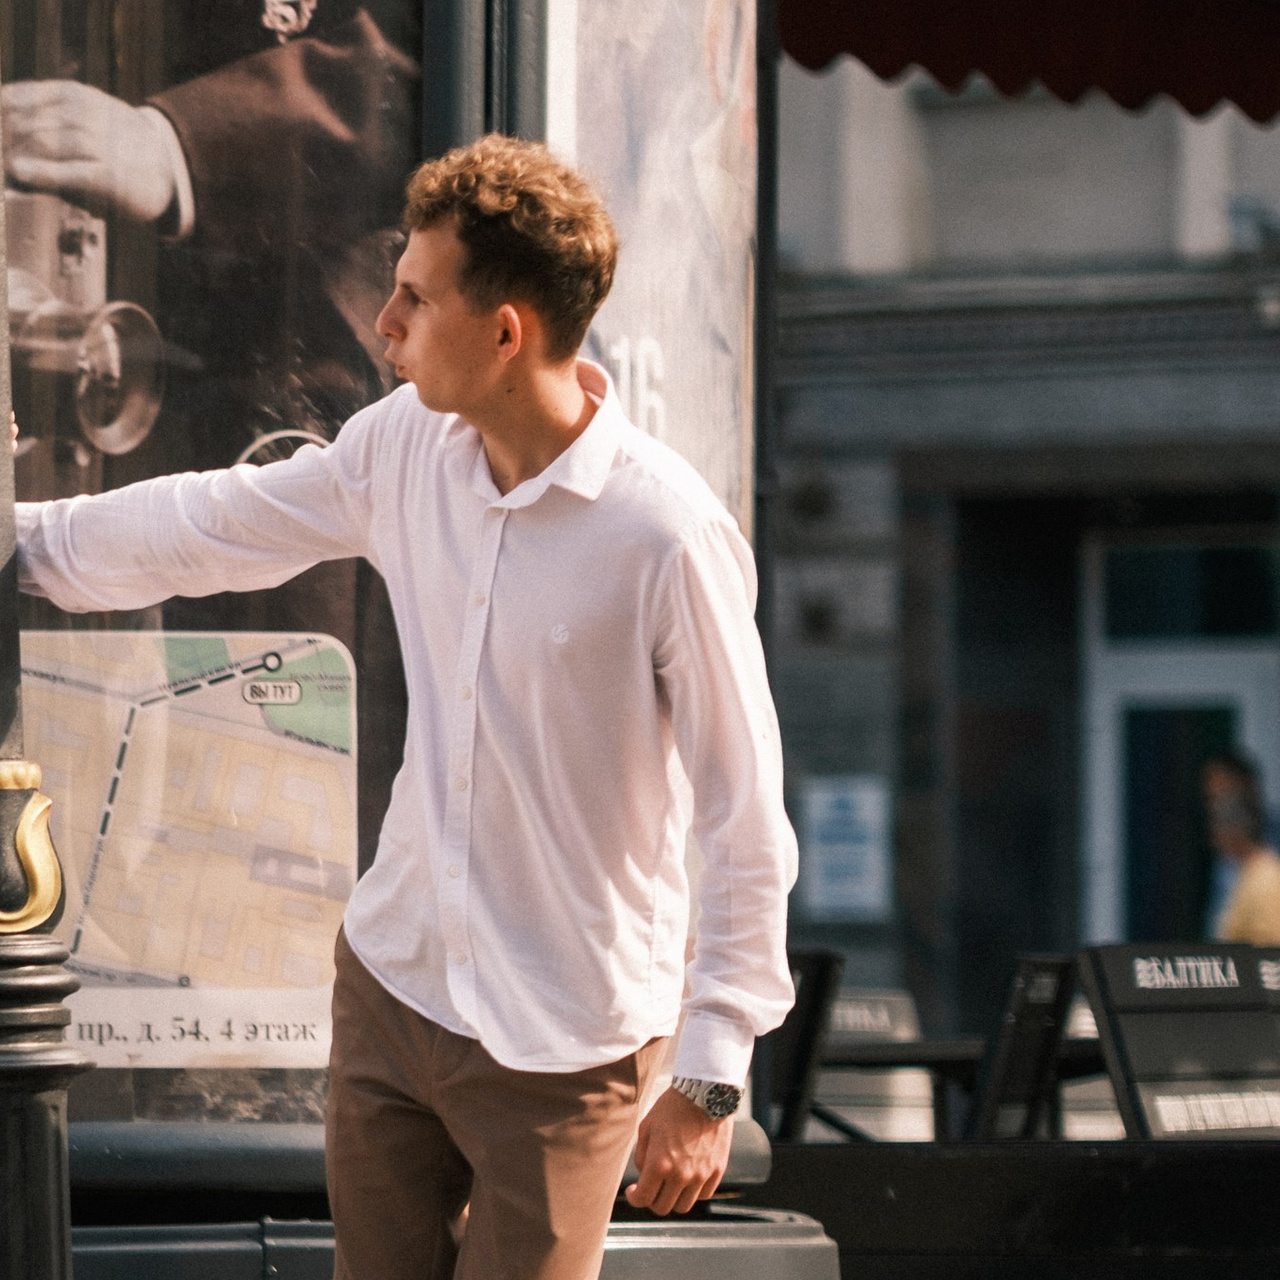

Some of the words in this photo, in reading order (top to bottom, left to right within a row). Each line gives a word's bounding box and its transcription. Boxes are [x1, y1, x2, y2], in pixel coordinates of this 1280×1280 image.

[273, 684, 294, 699] ТУТ
[219, 1017, 235, 1041] 4
[243, 1022, 317, 1042] этаж
